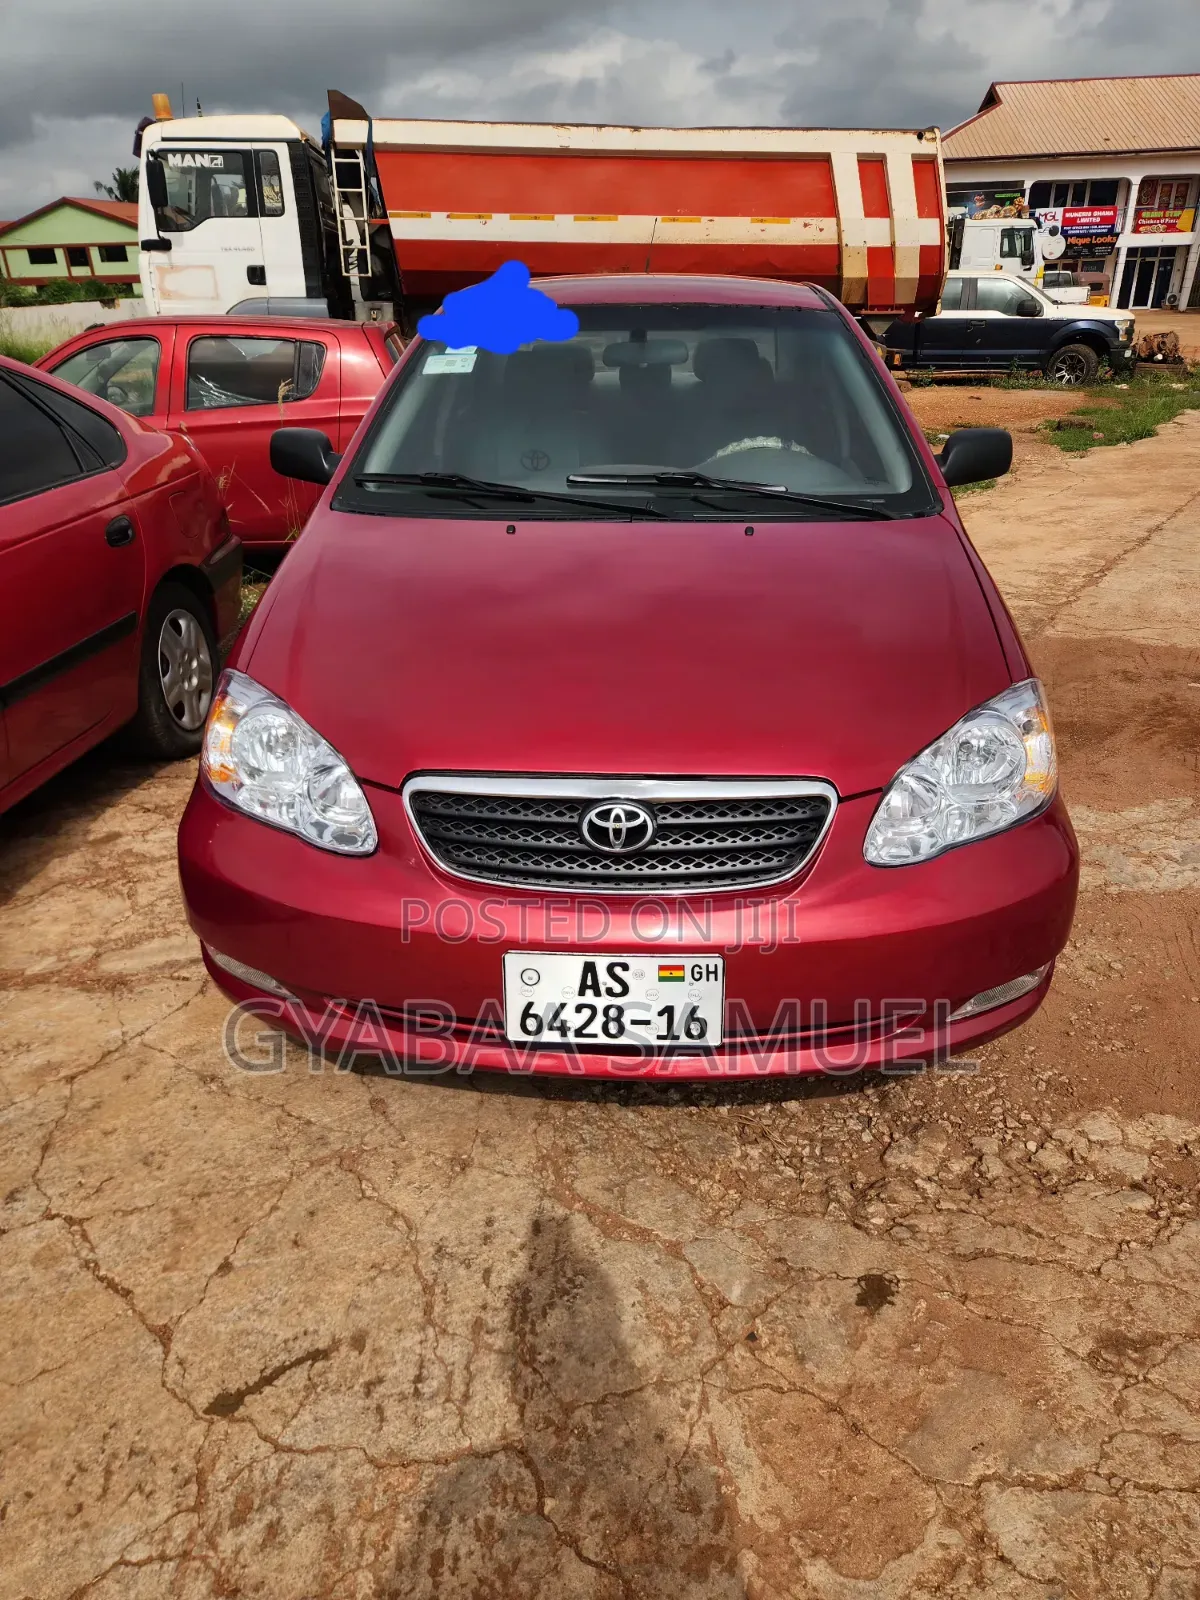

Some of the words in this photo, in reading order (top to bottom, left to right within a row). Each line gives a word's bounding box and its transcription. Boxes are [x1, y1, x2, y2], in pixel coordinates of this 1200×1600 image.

[167, 153, 209, 167] MAN
[1038, 211, 1060, 222] MGL
[1067, 236, 1091, 245] Nique
[1092, 235, 1117, 244] Looks
[577, 960, 630, 998] AS
[690, 963, 718, 982] GH
[519, 1001, 708, 1040] 6428-16
